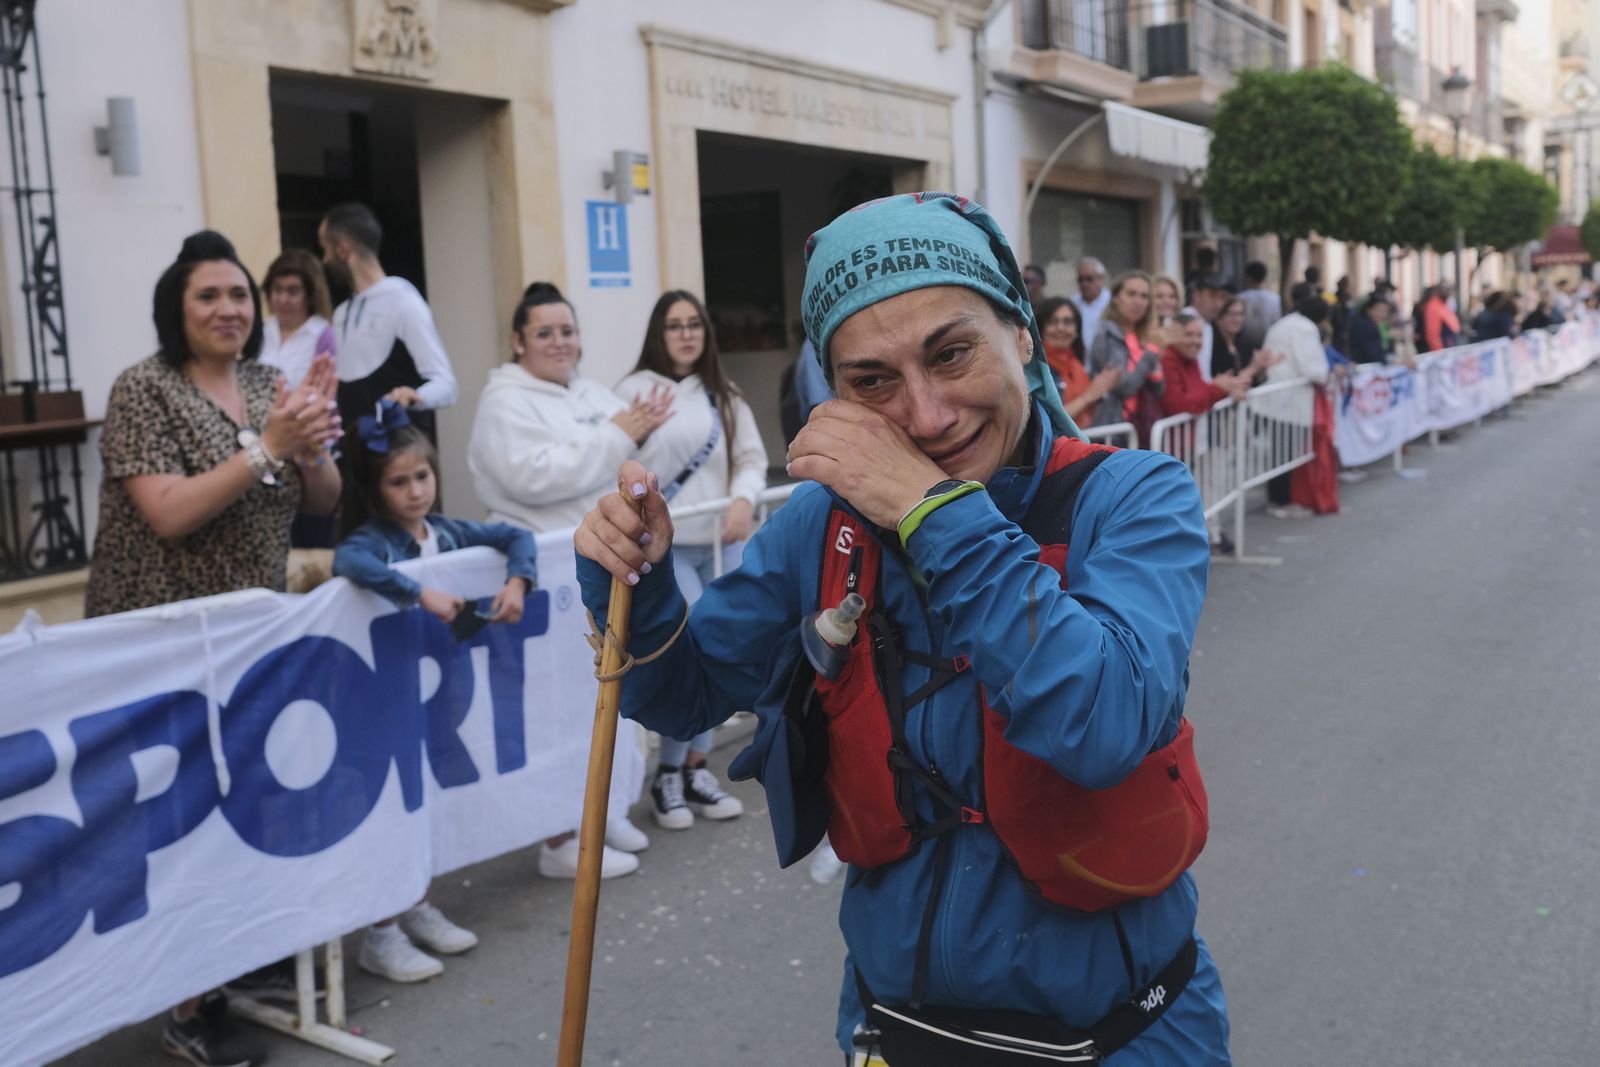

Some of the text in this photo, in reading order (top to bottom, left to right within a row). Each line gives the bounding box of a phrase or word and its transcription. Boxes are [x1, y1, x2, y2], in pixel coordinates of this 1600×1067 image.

[709, 77, 788, 118] HOTEL
[595, 206, 621, 250] H
[808, 259, 847, 313] DOLOR
[851, 244, 878, 267] ES
[864, 252, 931, 281] PARA
